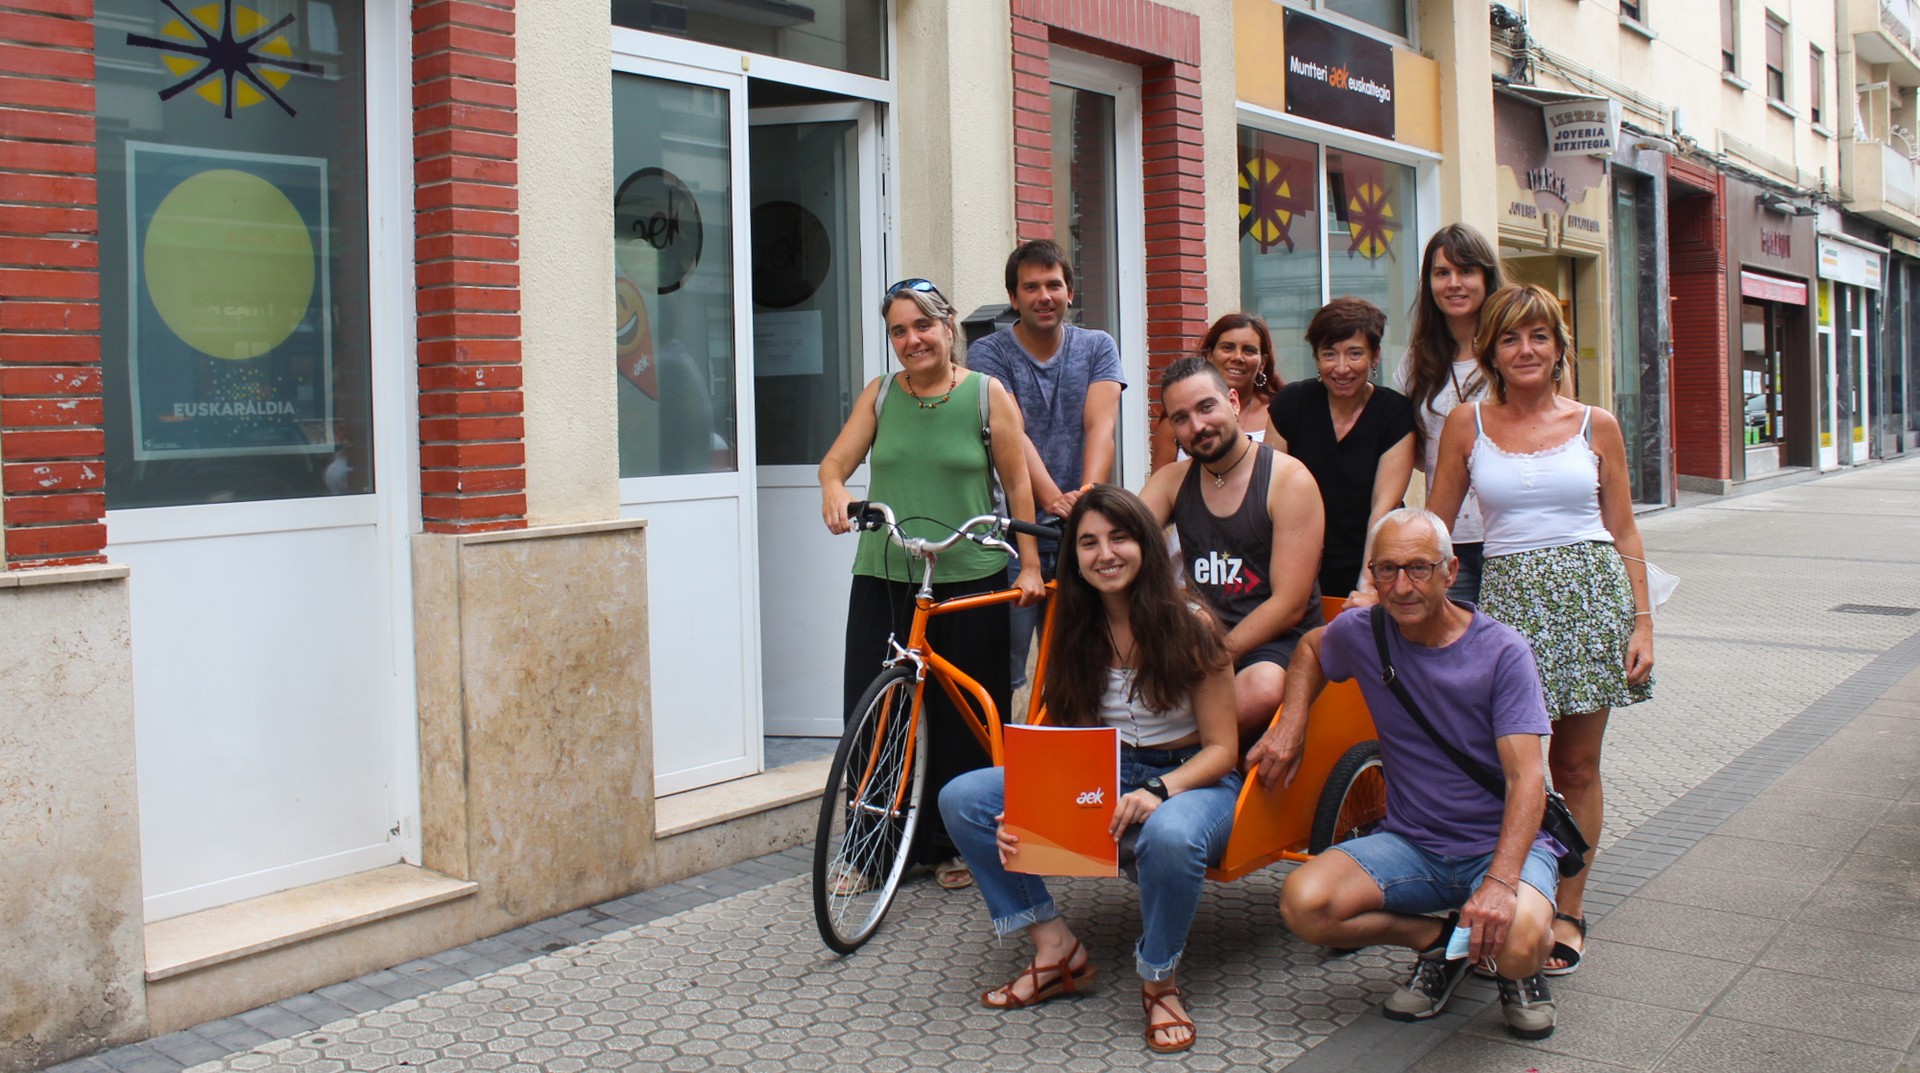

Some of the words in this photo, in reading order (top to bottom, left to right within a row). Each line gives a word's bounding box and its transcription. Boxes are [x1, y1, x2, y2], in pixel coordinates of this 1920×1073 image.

[1290, 55, 1328, 83] Muntteri
[1328, 63, 1349, 91] aek
[1348, 76, 1391, 104] euskaltegia
[1555, 128, 1605, 140] JOYERIA
[1553, 138, 1610, 152] BITXITEGIA
[633, 353, 650, 377] aek
[1194, 550, 1243, 585] ehz
[1076, 787, 1104, 805] aek
